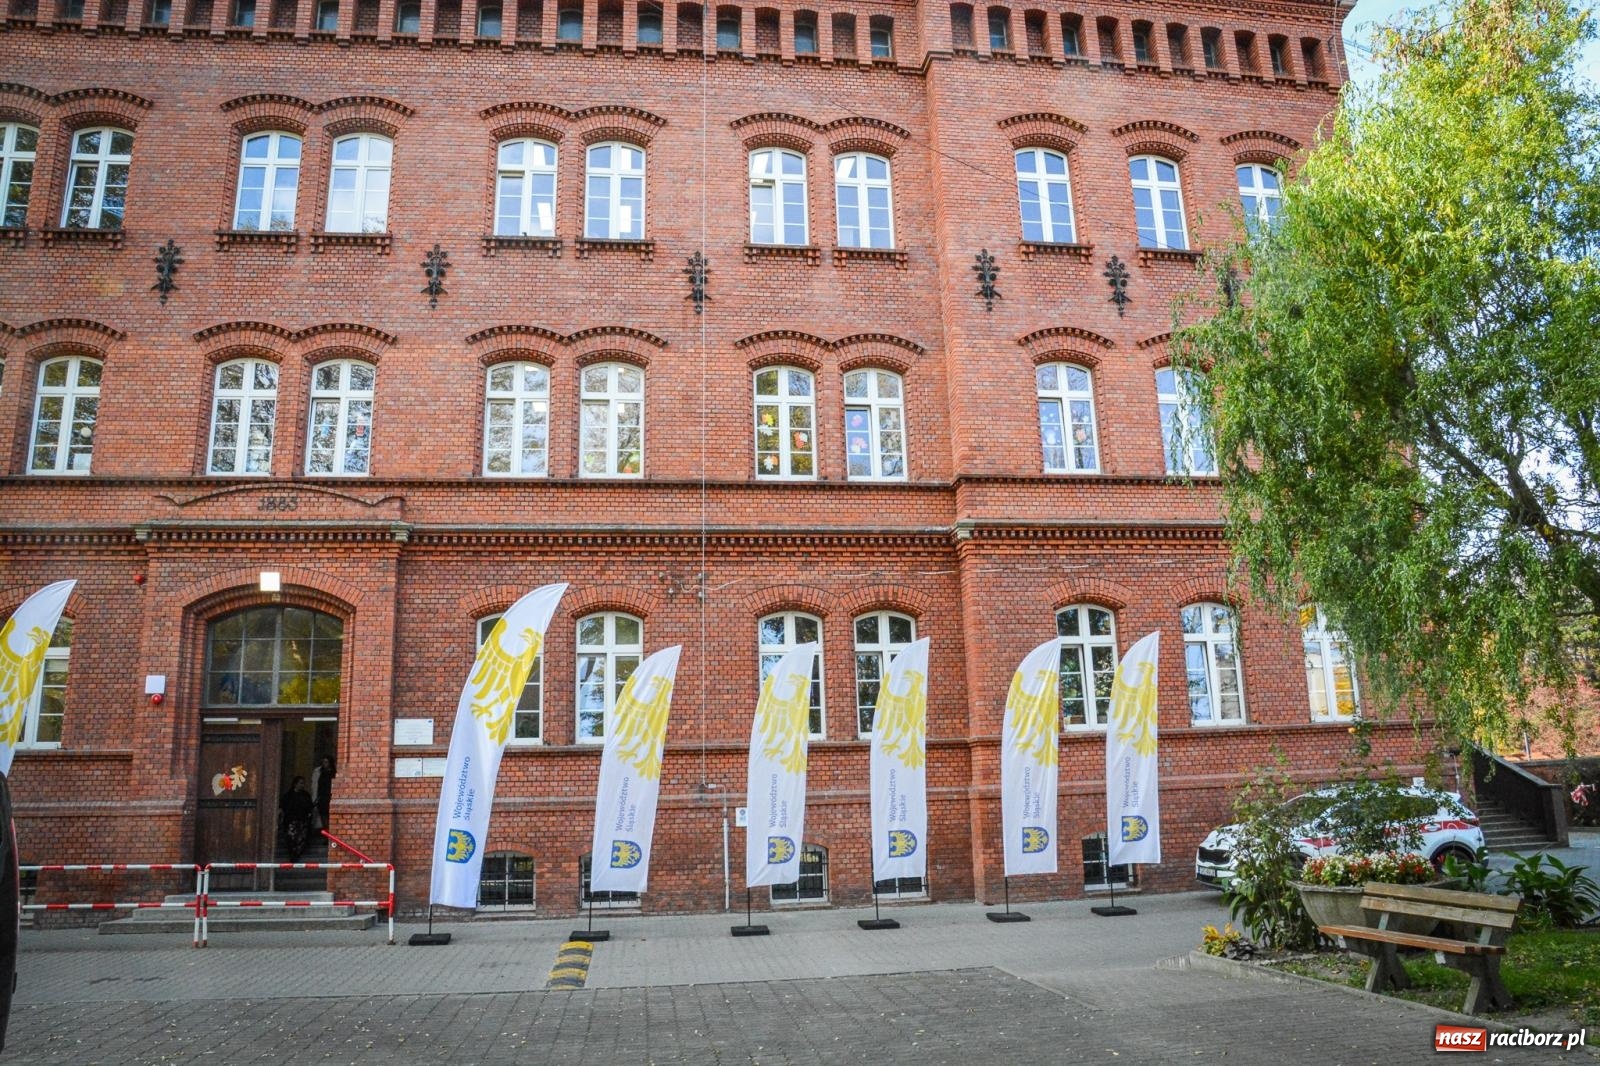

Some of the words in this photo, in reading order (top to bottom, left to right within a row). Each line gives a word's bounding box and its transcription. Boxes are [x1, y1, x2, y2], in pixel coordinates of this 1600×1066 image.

[453, 756, 470, 819] Województwo
[464, 788, 475, 821] Śląskie
[615, 776, 629, 832] Województwo
[768, 773, 778, 828] Województwo
[888, 768, 897, 822] Województwo
[1023, 766, 1031, 819] Województwo
[1122, 756, 1131, 808] Województwo
